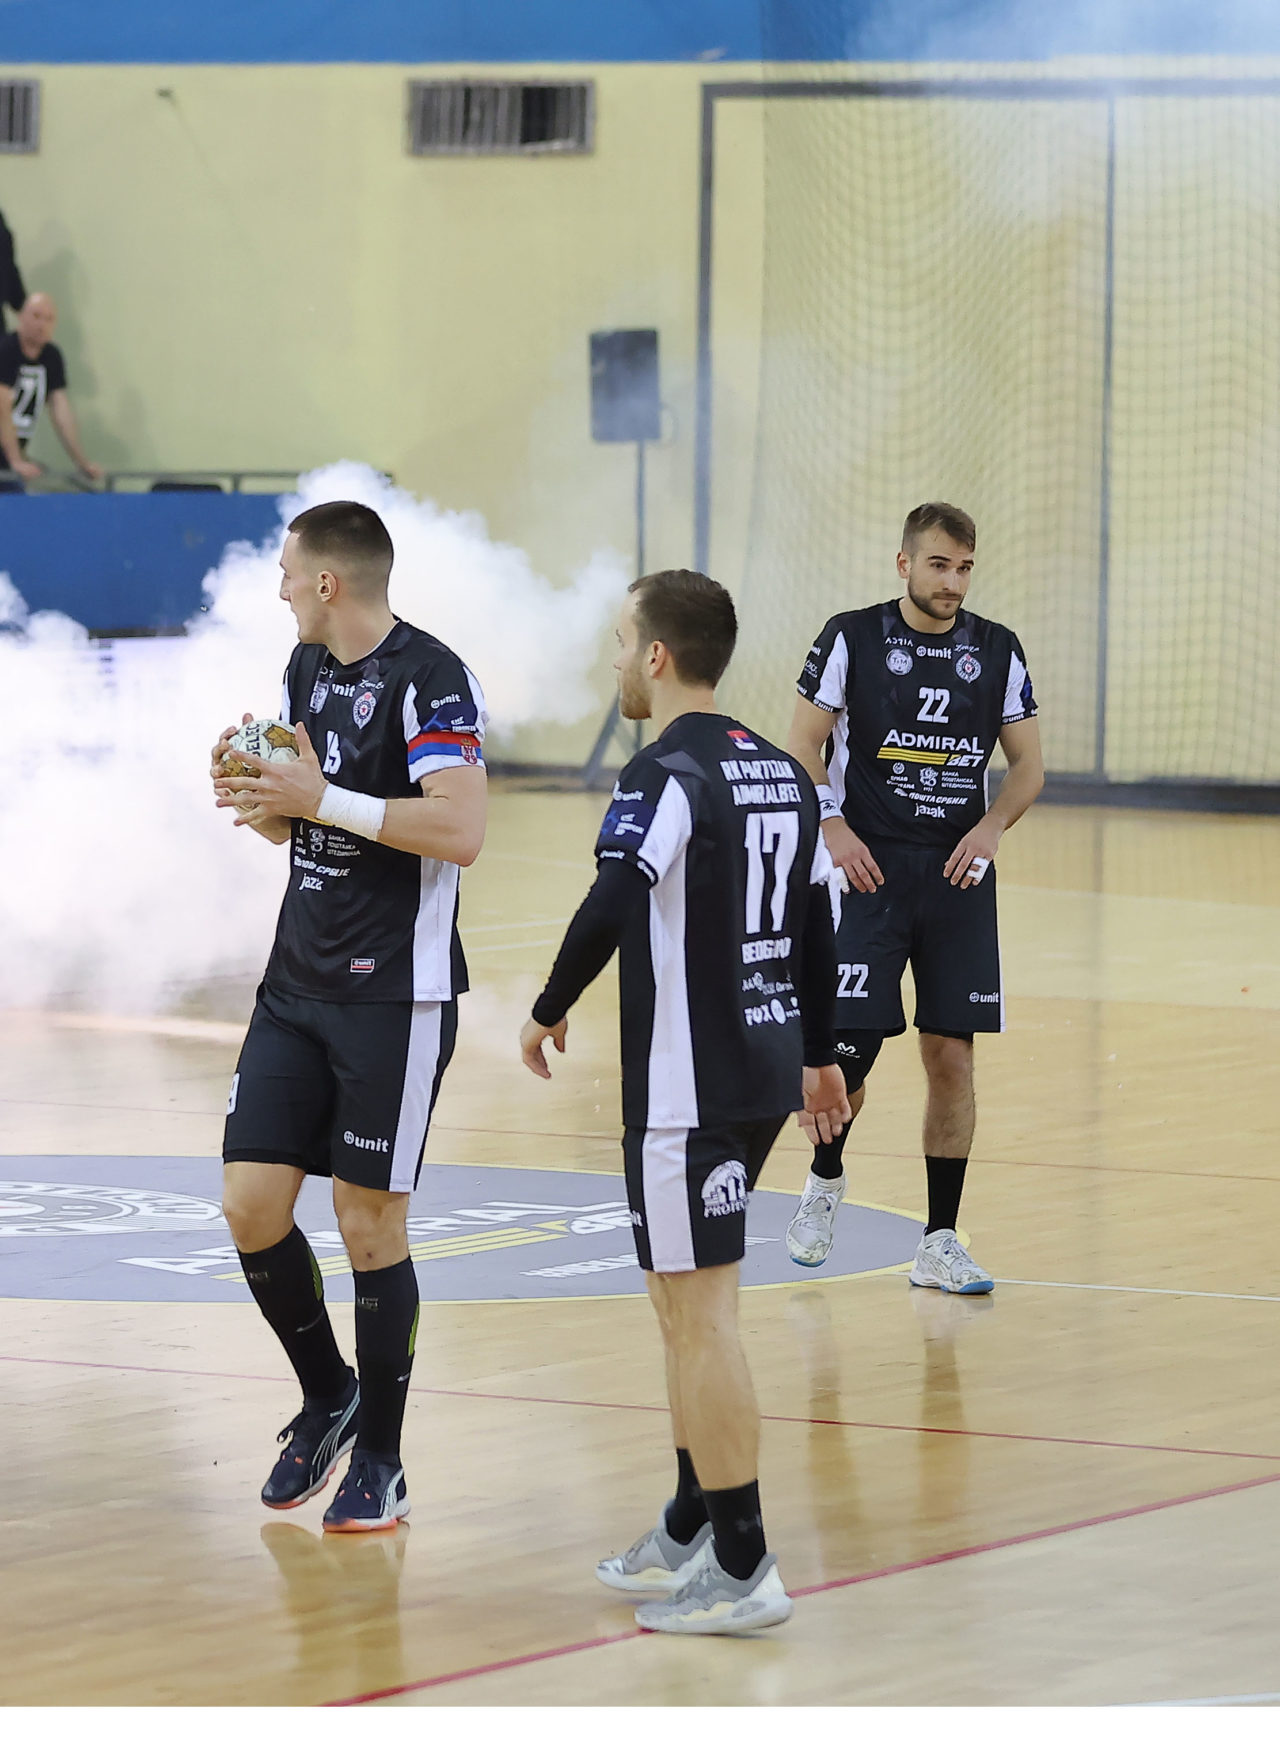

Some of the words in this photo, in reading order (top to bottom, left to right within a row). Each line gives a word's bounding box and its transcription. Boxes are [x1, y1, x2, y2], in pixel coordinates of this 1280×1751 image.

[927, 647, 952, 660] unit
[440, 693, 462, 706] unit
[916, 687, 951, 724] 22
[882, 729, 984, 754] ADMIRAL
[914, 802, 946, 818] jazak
[744, 810, 800, 934] 17
[836, 963, 870, 998] 22
[980, 992, 1000, 1003] unit
[354, 1136, 389, 1153] unit
